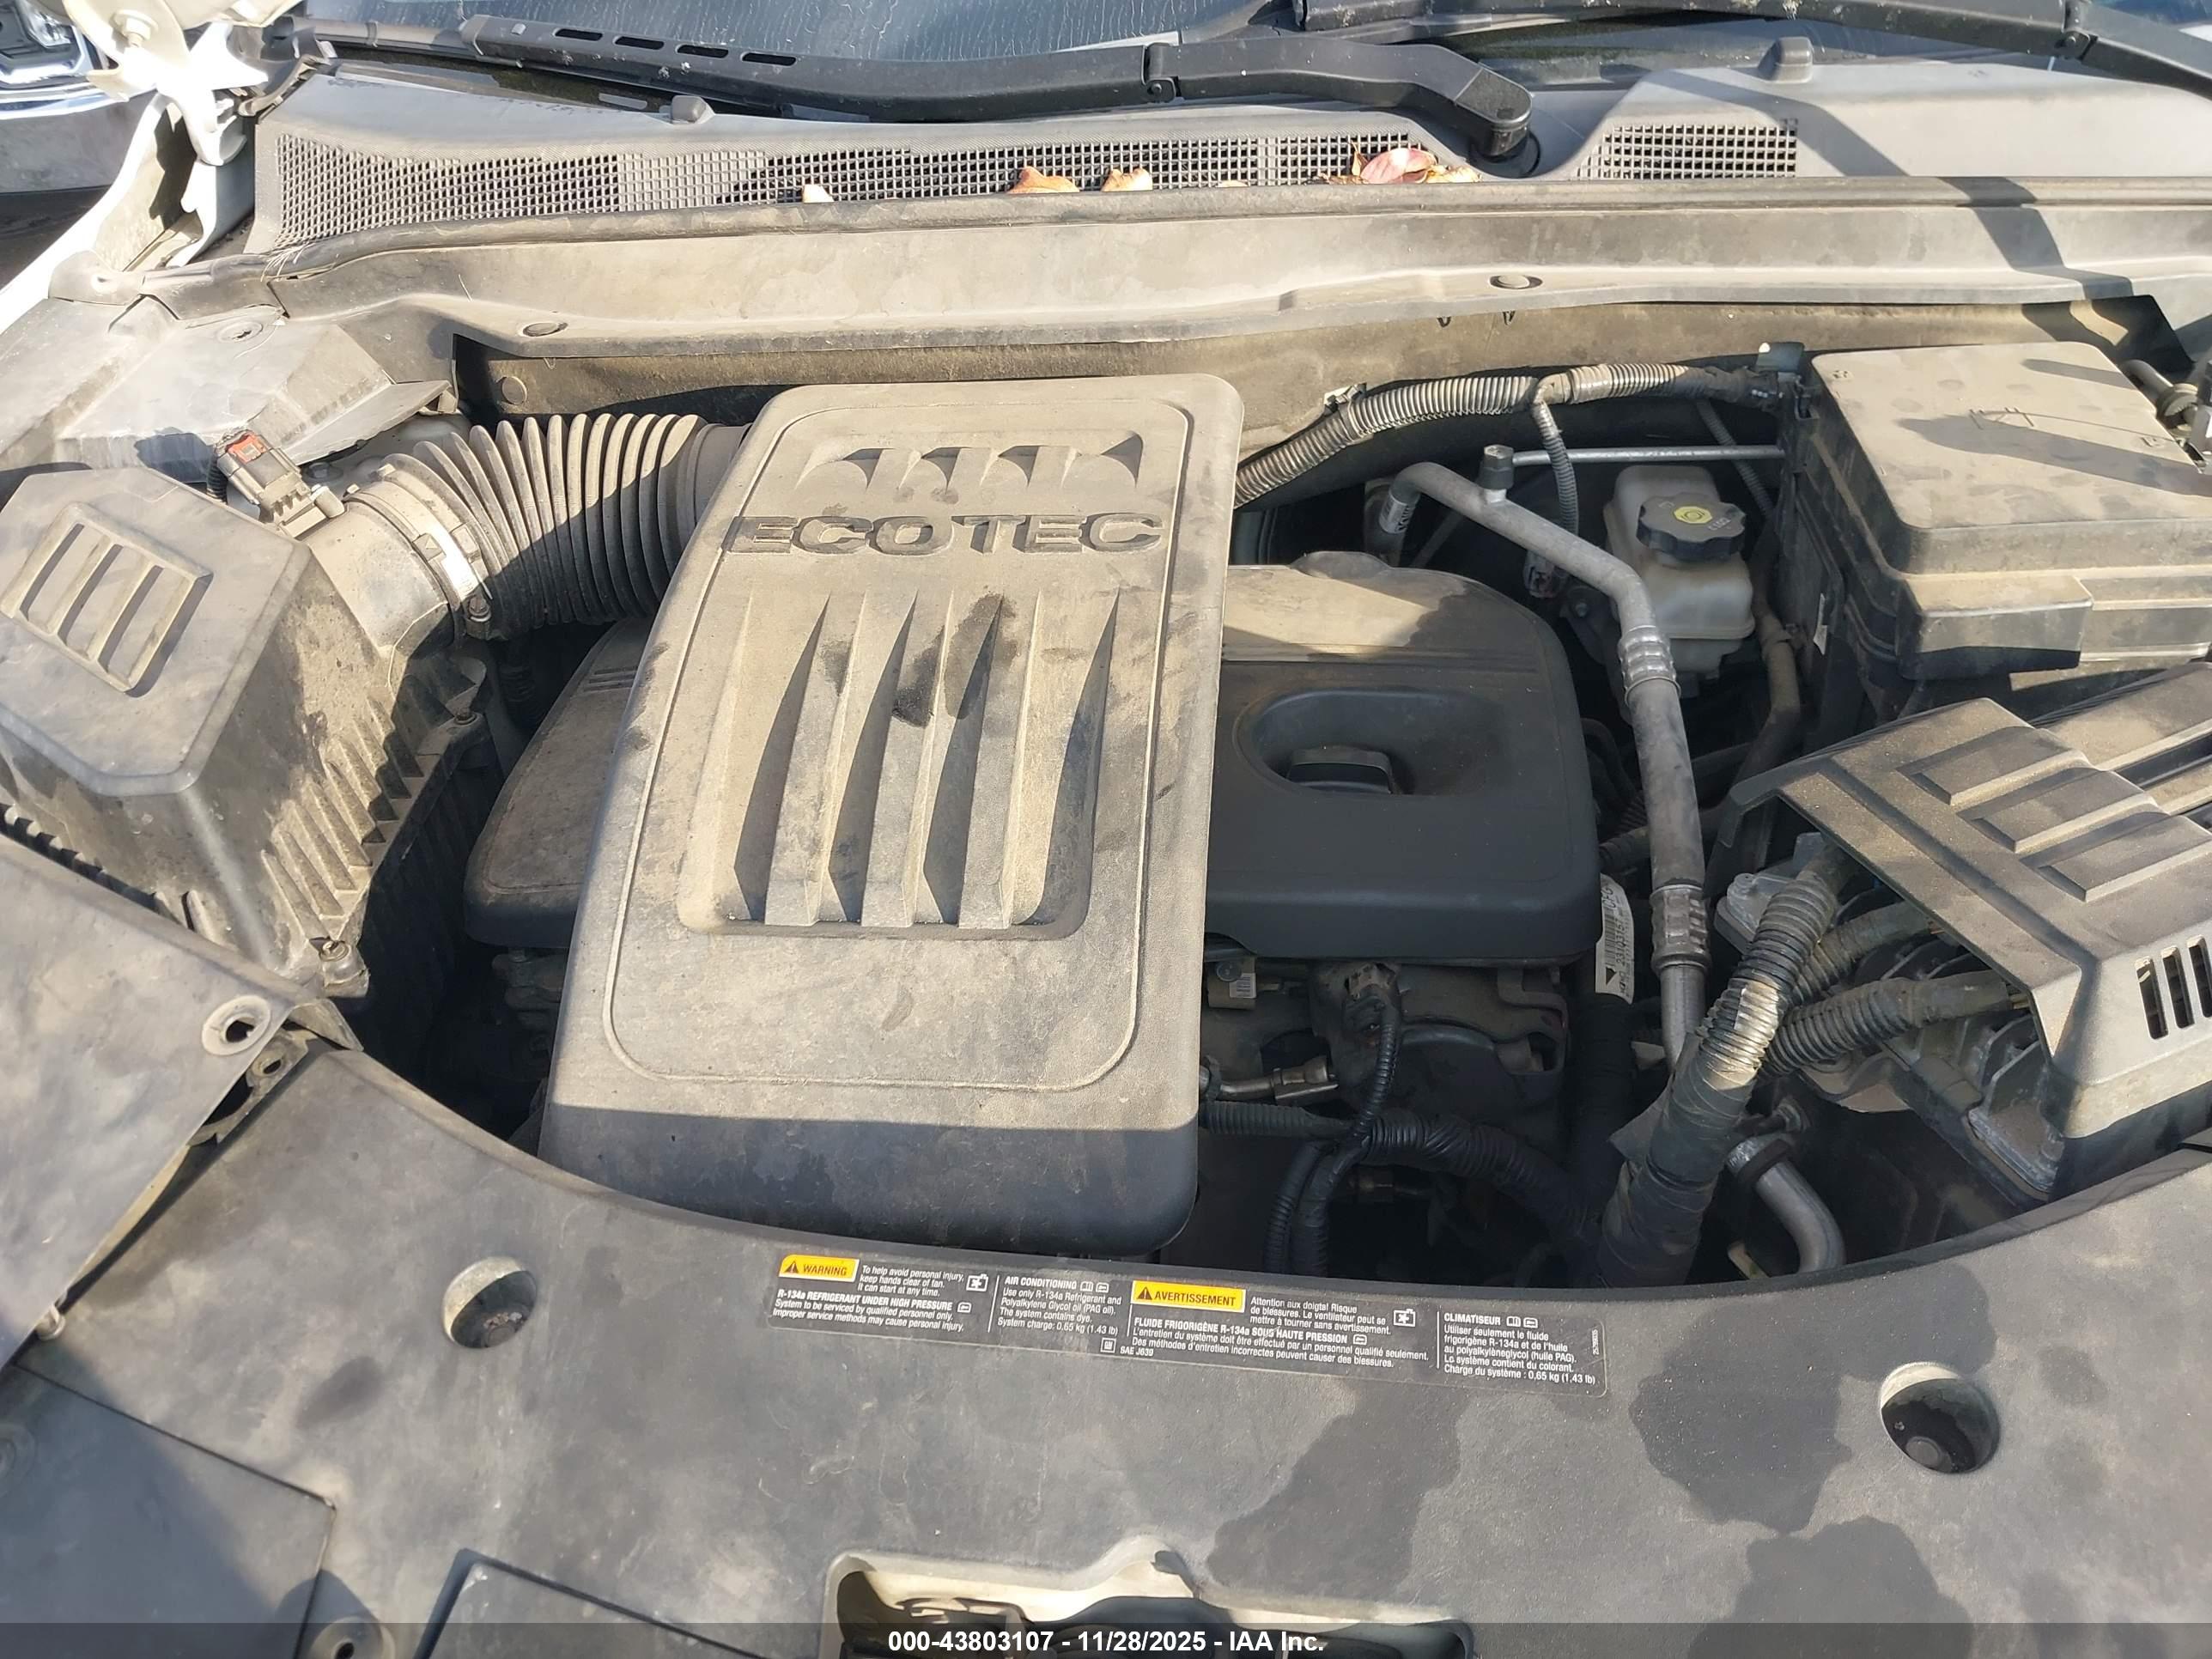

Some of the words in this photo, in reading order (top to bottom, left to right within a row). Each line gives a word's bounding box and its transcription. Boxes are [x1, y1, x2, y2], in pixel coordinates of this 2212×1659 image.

[720, 513, 1165, 556] ECOTEC
[803, 1265, 847, 1276] WARNING
[863, 1266, 871, 1274] To
[872, 1267, 887, 1277] help
[890, 1267, 909, 1277] avoid
[911, 1269, 941, 1281] personal
[858, 1283, 862, 1291] It
[879, 1285, 896, 1293] start
[907, 1288, 921, 1297] any
[922, 1288, 939, 1297] time.
[860, 1274, 878, 1284] keep
[879, 1276, 901, 1285] hands
[903, 1278, 920, 1286] clear
[922, 1279, 929, 1287] of
[932, 1279, 945, 1288] fan.
[1005, 1276, 1018, 1285] AIR
[1021, 1277, 1077, 1290] CONDITIONING
[777, 1289, 805, 1299] R-134a
[807, 1291, 860, 1304] REFRIGERANT
[862, 1295, 888, 1306] UNDER
[890, 1297, 909, 1308] HIGH
[911, 1299, 952, 1311] PRESSURE
[1003, 1287, 1016, 1297] Use
[1018, 1289, 1034, 1299] only
[1036, 1291, 1062, 1300] R-134a
[1065, 1292, 1105, 1305] Refrigerant
[1108, 1296, 1121, 1304] and
[1154, 1291, 1236, 1306] AVERTISSEMENT
[775, 1298, 802, 1310] System
[804, 1301, 811, 1310] to
[812, 1301, 822, 1310] be
[823, 1303, 854, 1313] serviced
[855, 1304, 865, 1314] by
[866, 1305, 897, 1316] qualified
[898, 1308, 935, 1320] personnel
[937, 1311, 953, 1322] only.
[1000, 1307, 1012, 1316] The
[1016, 1309, 1042, 1320] system
[1043, 1310, 1074, 1322] contains
[1077, 1314, 1091, 1323] dye.
[1001, 1297, 1046, 1310] Polyalkylene
[1048, 1301, 1070, 1312] Glycol
[1073, 1303, 1081, 1311] oil
[1083, 1304, 1100, 1314] (PAG
[1103, 1305, 1115, 1316] oil).
[1251, 1297, 1285, 1307] Attention
[1331, 1304, 1357, 1315] Risque
[773, 1308, 806, 1321] Improper
[806, 1311, 833, 1321] service
[835, 1313, 866, 1323] methods
[867, 1317, 884, 1326] may
[885, 1318, 907, 1327] cause
[908, 1319, 940, 1330] personal
[942, 1322, 963, 1332] injury.
[1250, 1306, 1260, 1315] de
[1262, 1307, 1300, 1318] blessures.
[1304, 1310, 1312, 1319] Le
[1315, 1311, 1355, 1322] ventilateur
[1358, 1315, 1375, 1325] peut
[1444, 1312, 1501, 1326] CLIMATISEUR
[998, 1316, 1024, 1328] System
[1027, 1320, 1054, 1331] charge:
[1056, 1322, 1073, 1331] 0.65
[1076, 1323, 1085, 1334] kg
[1087, 1324, 1107, 1335] (1.43
[1109, 1326, 1118, 1336] lb)
[1134, 1317, 1162, 1328] FLUIDE
[1164, 1319, 1218, 1333] FRIGORIGÈNE
[1220, 1325, 1249, 1335] R-134a
[1252, 1328, 1274, 1338] SOUS
[1276, 1329, 1304, 1340] HAUTE
[1306, 1332, 1347, 1343] PRESSION
[1250, 1316, 1274, 1325] mettre
[1285, 1318, 1312, 1328] tourner
[1334, 1322, 1390, 1334] avertissement.
[1444, 1324, 1471, 1334] Utiliser
[1474, 1327, 1515, 1339] seulement
[1517, 1330, 1524, 1340] le
[1527, 1331, 1548, 1341] fluide
[1120, 1346, 1134, 1355] SAE
[1133, 1327, 1172, 1339] L'entretien
[1175, 1330, 1183, 1340] du
[1187, 1331, 1218, 1344] système
[1220, 1334, 1234, 1344] doit
[1237, 1335, 1251, 1346] être
[1254, 1337, 1285, 1348] effectué
[1287, 1341, 1299, 1350] par
[1315, 1343, 1352, 1354] personnel
[1355, 1345, 1382, 1358] qualifié
[1386, 1348, 1428, 1360] seulement.
[1133, 1337, 1146, 1346] Des
[1149, 1338, 1186, 1349] méthodes
[1188, 1341, 1229, 1353] d'entretien
[1231, 1346, 1273, 1357] incorrectes
[1276, 1349, 1306, 1361] peuvent
[1309, 1353, 1334, 1363] causer
[1338, 1355, 1352, 1364] des
[1354, 1356, 1394, 1367] blessures.
[1443, 1334, 1486, 1347] frigorigène
[1489, 1338, 1519, 1348] R-134a
[1531, 1341, 1541, 1350] de
[1544, 1342, 1567, 1352] l'huile
[1456, 1356, 1489, 1367] système
[1492, 1358, 1524, 1369] contient
[1527, 1361, 1536, 1370] du
[1539, 1362, 1573, 1372] colorant.
[1531, 1351, 1553, 1361] (huile
[1555, 1352, 1577, 1363] PAG).
[1444, 1364, 1472, 1376] Charge
[1475, 1366, 1485, 1376] du
[1487, 1368, 1521, 1379] système
[1528, 1370, 1547, 1382] 0,65
[1549, 1372, 1559, 1382] kg
[1585, 1375, 1595, 1384] lb)
